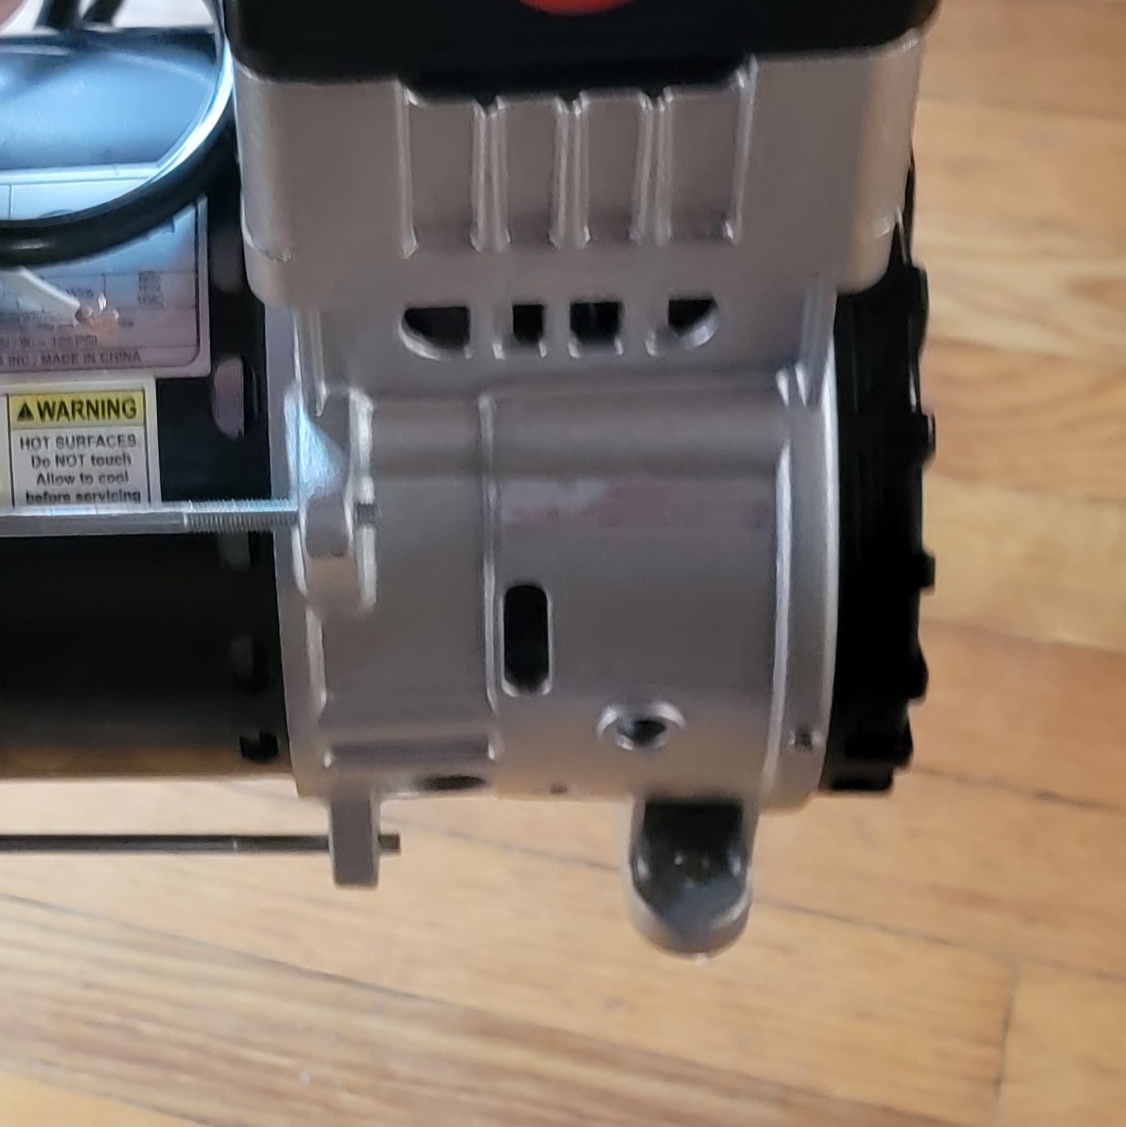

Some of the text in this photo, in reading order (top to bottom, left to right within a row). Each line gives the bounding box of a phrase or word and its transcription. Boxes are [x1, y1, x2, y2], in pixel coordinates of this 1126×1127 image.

[41, 351, 76, 365] MADE
[83, 351, 96, 364] IN
[100, 349, 142, 364] CHINA
[37, 397, 138, 422] WARNING
[20, 435, 50, 451] HOT
[31, 452, 132, 469] Do NOT touch
[37, 470, 129, 487] Allow to cool
[26, 488, 142, 505] before servicing
